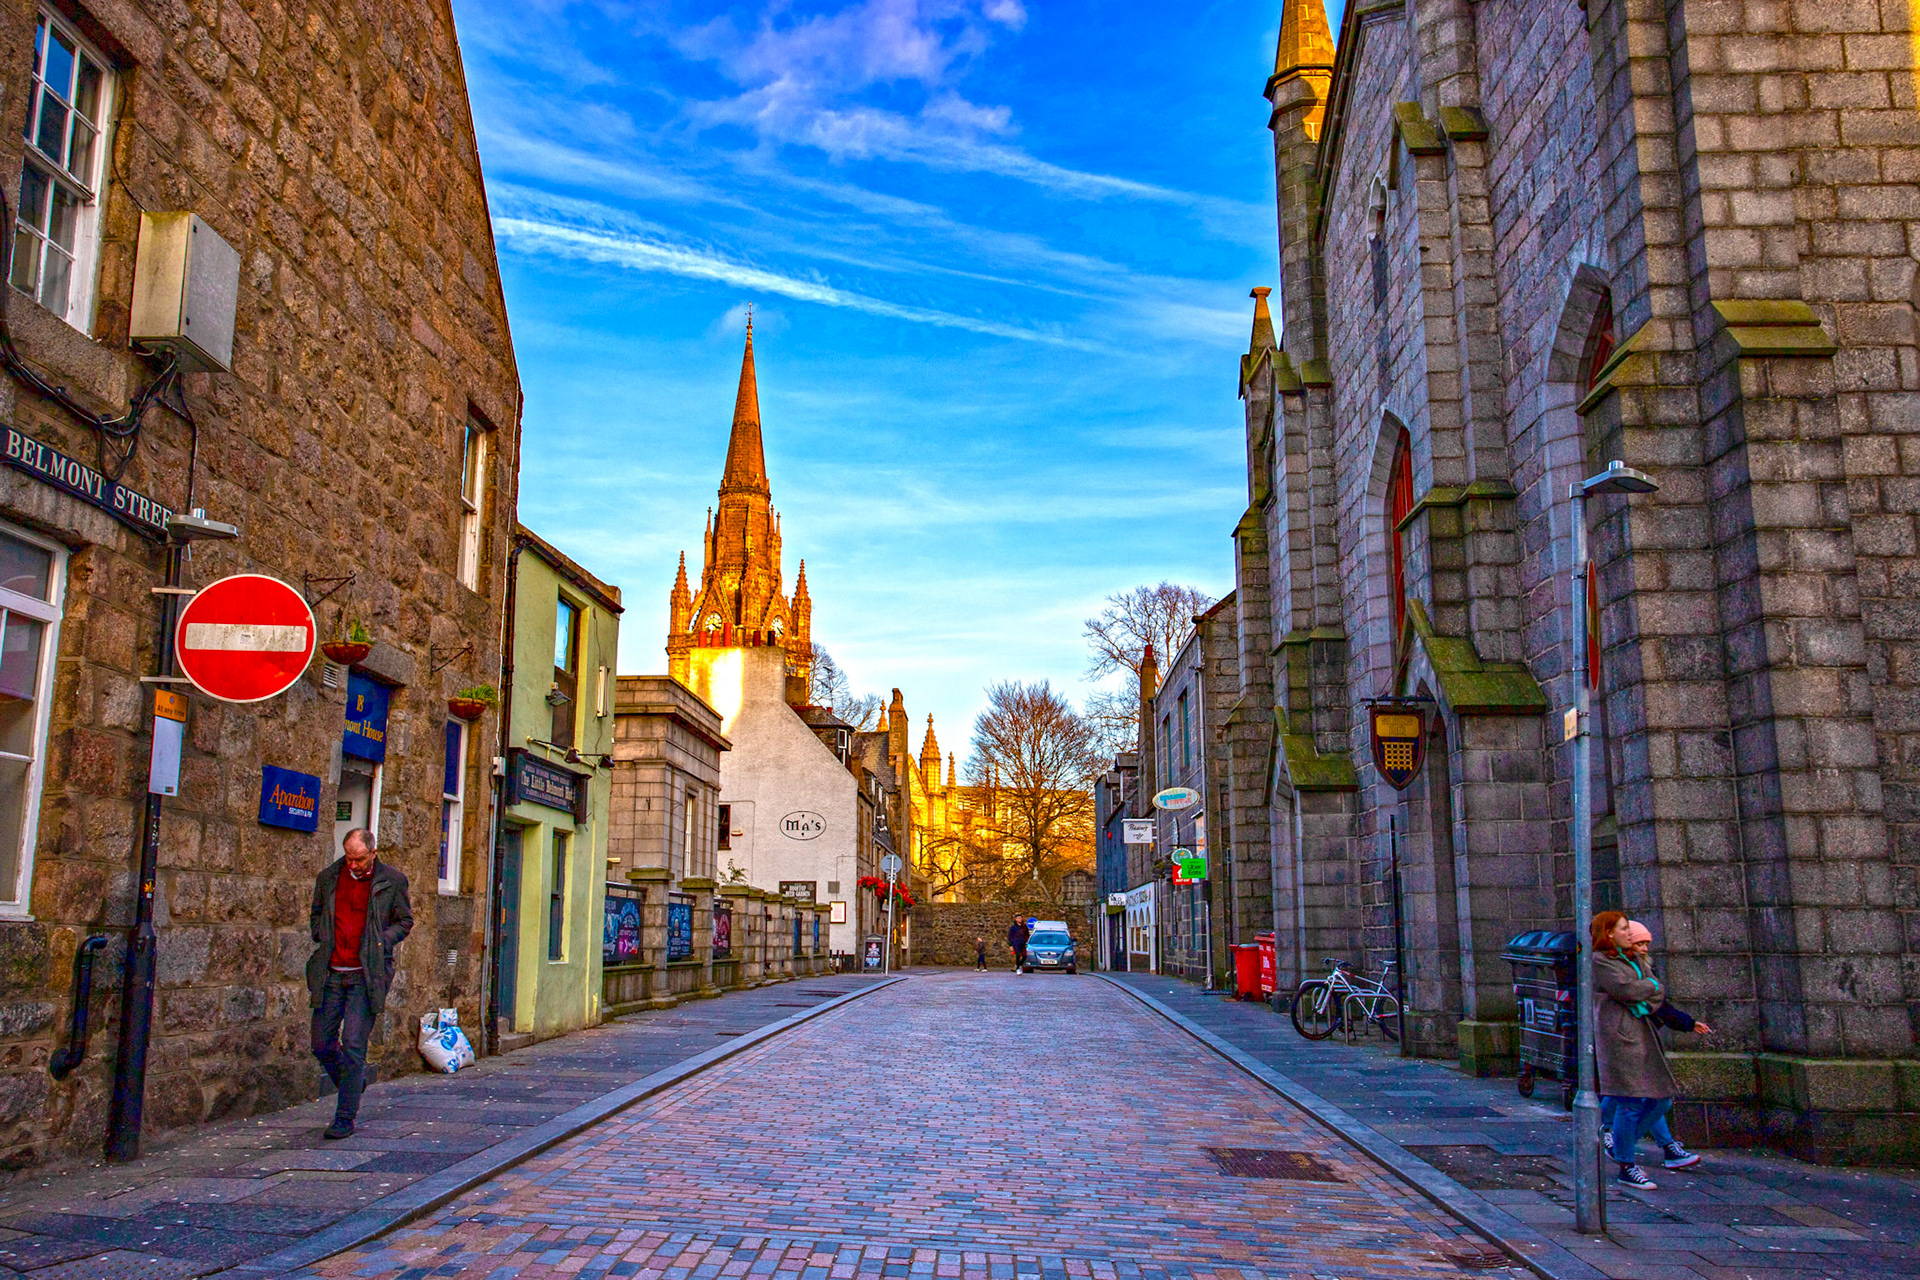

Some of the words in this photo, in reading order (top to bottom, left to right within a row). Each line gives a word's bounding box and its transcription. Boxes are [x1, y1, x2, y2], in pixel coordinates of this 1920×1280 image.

[6, 429, 107, 500] BELMONT
[113, 485, 173, 531] STREE
[157, 704, 164, 712] At
[164, 707, 173, 716] any
[174, 709, 185, 717] time
[356, 694, 365, 712] 18
[344, 718, 361, 735] mont
[362, 719, 384, 743] House
[269, 783, 315, 811] Apardion
[531, 774, 545, 792] Little
[546, 780, 564, 799] Belmont
